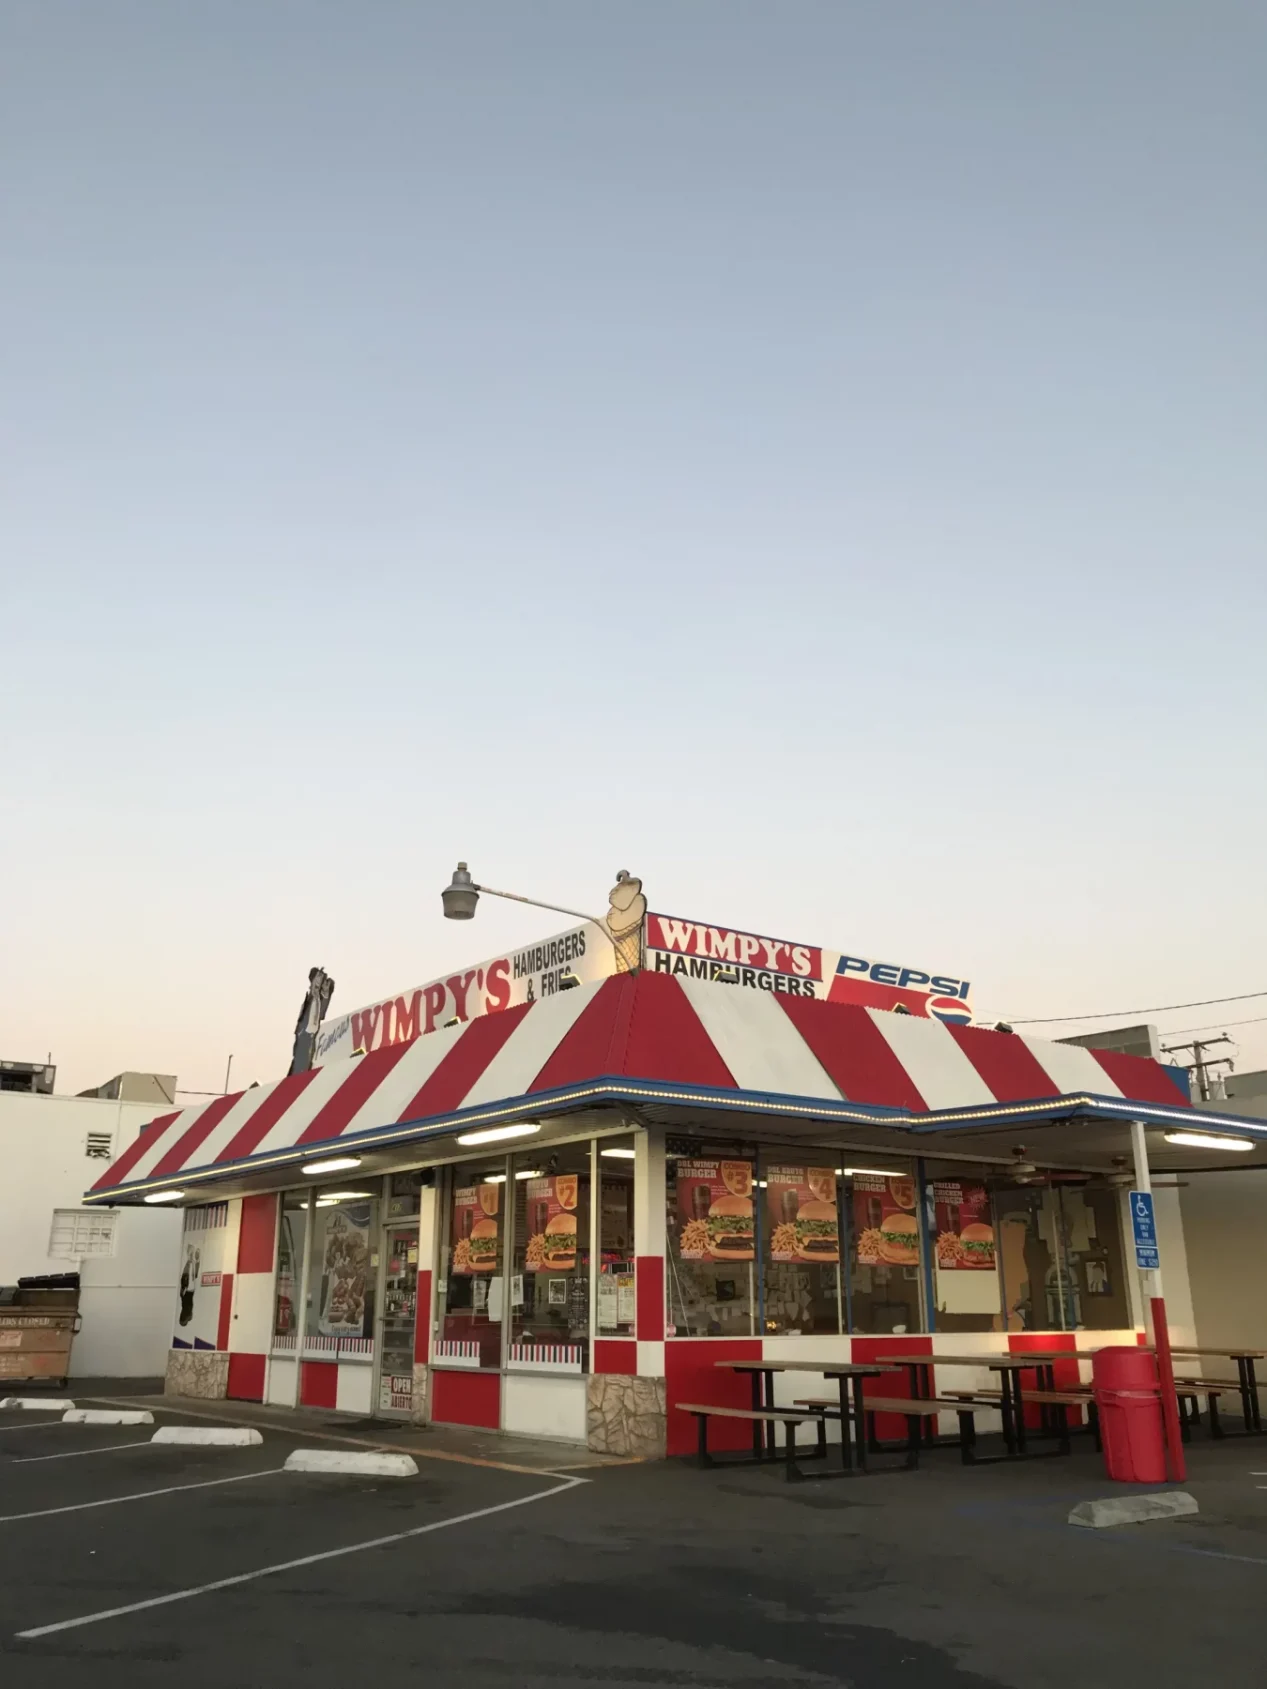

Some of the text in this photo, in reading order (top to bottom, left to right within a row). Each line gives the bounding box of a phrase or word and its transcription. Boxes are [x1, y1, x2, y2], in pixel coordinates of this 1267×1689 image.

[514, 930, 585, 979] HAMBURGERS
[657, 917, 811, 976] WIMPY'S
[835, 954, 970, 1000] PEPSI
[527, 978, 534, 1003] &
[350, 958, 511, 1053] WIMPY'S
[676, 1168, 717, 1179] BURGER
[692, 1161, 720, 1169] WIMPY
[767, 1173, 804, 1185] BURGER
[853, 1182, 887, 1193] BURGER
[393, 1377, 411, 1394] OPEN
